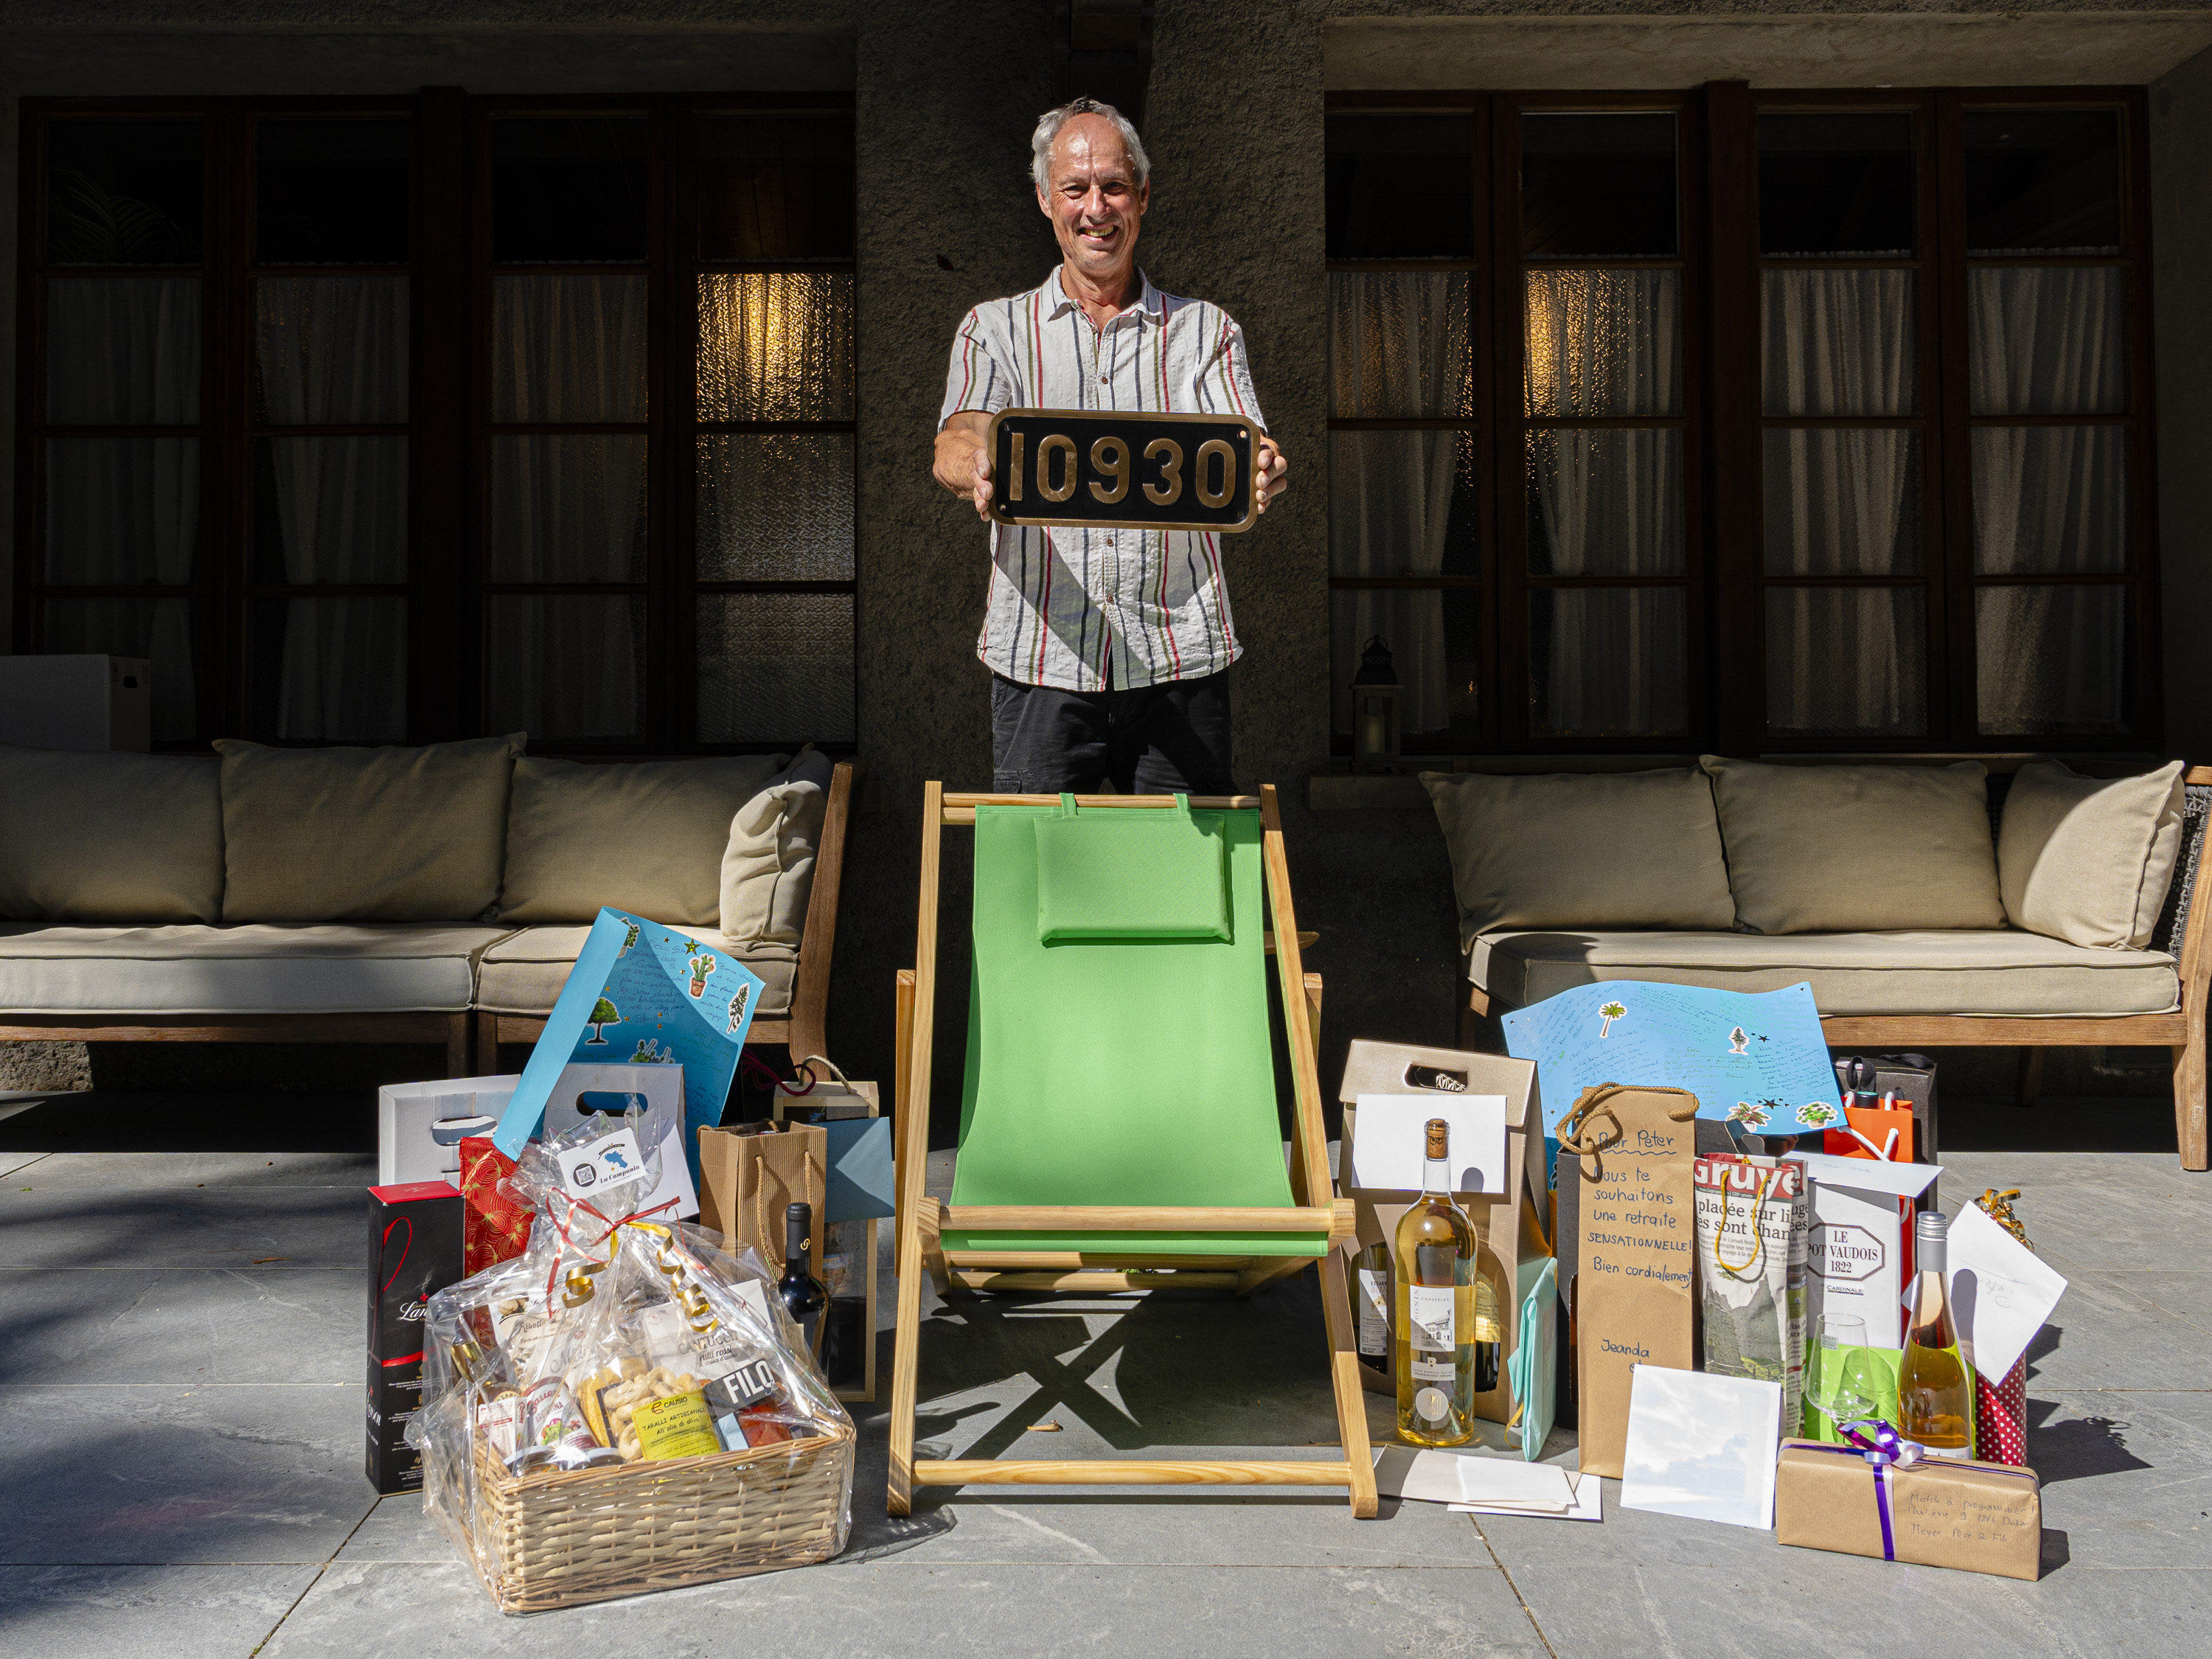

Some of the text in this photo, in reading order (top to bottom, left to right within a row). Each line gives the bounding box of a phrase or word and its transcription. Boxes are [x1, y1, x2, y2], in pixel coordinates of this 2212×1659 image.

[1009, 432, 1237, 509] 10930
[1599, 1130, 1674, 1149] Pour Peter
[609, 1165, 640, 1180] Campania
[1593, 1165, 1650, 1182] Nous te
[1594, 1187, 1674, 1205] souhaitons
[1593, 1209, 1676, 1228] une retraite
[1714, 1220, 1747, 1235] sont
[1587, 1232, 1692, 1255] SENSATIONNELLE!
[1834, 1231, 1848, 1243] LE
[1807, 1243, 1826, 1256] POT
[1830, 1246, 1879, 1261] VAUDOIS
[1593, 1256, 1693, 1289] Bien cordialement
[1830, 1260, 1851, 1273] 1822
[397, 1301, 428, 1321] Lan
[716, 1345, 732, 1357] rossi
[1601, 1339, 1649, 1357] Jeanda
[723, 1360, 775, 1405] FILO
[664, 1397, 688, 1408] CAUSIO
[642, 1407, 706, 1431] TARALLI ARTIGIANALI
[1910, 1492, 1940, 1503] Match
[1964, 1500, 2026, 1514] programmer
[1913, 1523, 1942, 1537] Meyer
[1952, 1528, 1972, 1540] Père
